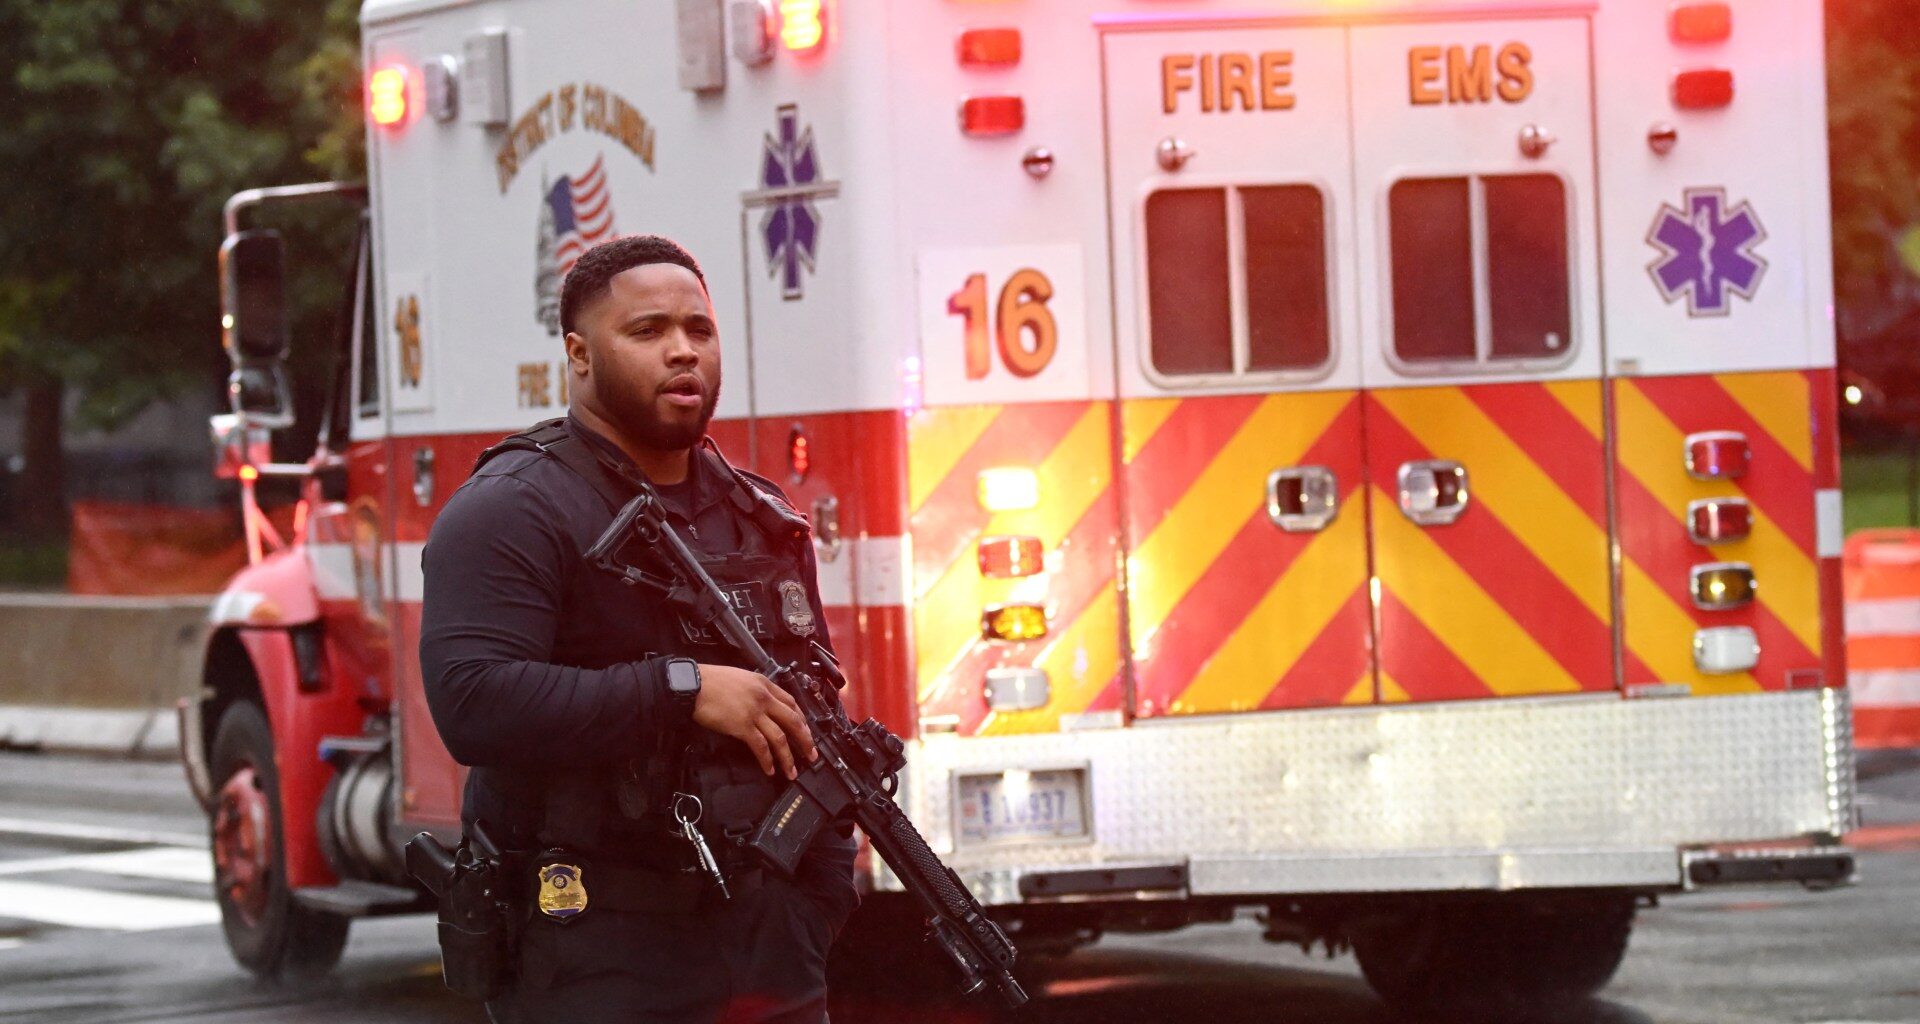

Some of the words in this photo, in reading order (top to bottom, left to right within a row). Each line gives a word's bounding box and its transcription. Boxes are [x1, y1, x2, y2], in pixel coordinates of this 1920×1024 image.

[1162, 51, 1295, 113] FIRE
[1409, 42, 1534, 105] EMS
[558, 83, 577, 132] OF
[584, 82, 656, 173] COLUMBIA
[395, 294, 421, 388] 16
[947, 268, 1058, 379] 16
[517, 362, 550, 407] FIRE
[687, 613, 767, 640] SECE
